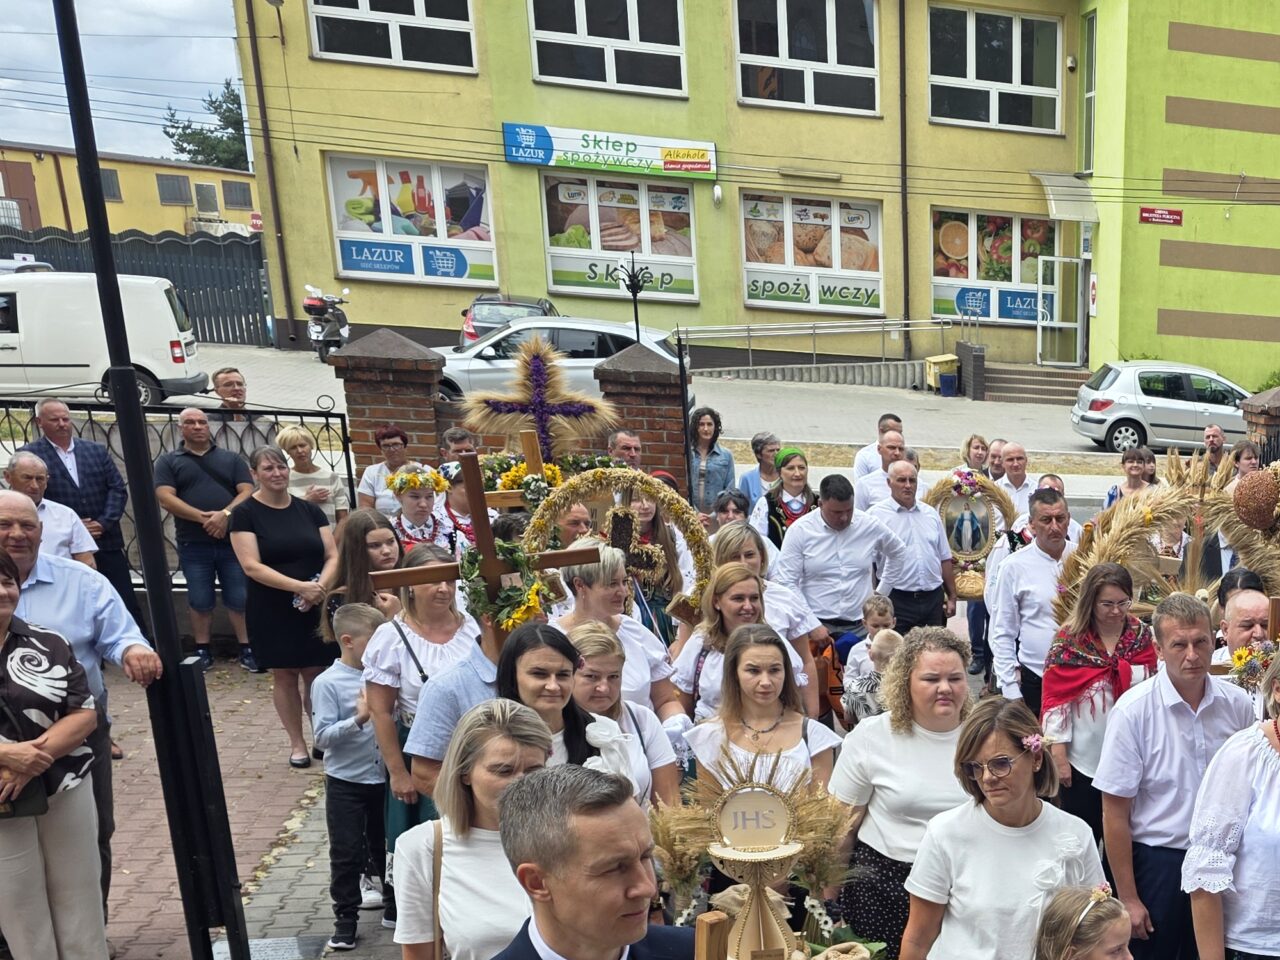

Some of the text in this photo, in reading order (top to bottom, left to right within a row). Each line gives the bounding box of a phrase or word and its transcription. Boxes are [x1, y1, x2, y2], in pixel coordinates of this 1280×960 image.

[512, 147, 545, 158] LAZUR
[581, 134, 637, 155] Sklep
[562, 151, 654, 169] spożywczy
[664, 150, 706, 159] Alkohole
[351, 247, 405, 263] LAZUR
[587, 263, 674, 289] Skep
[750, 278, 876, 304] spożywczy
[732, 809, 776, 831] JHS
